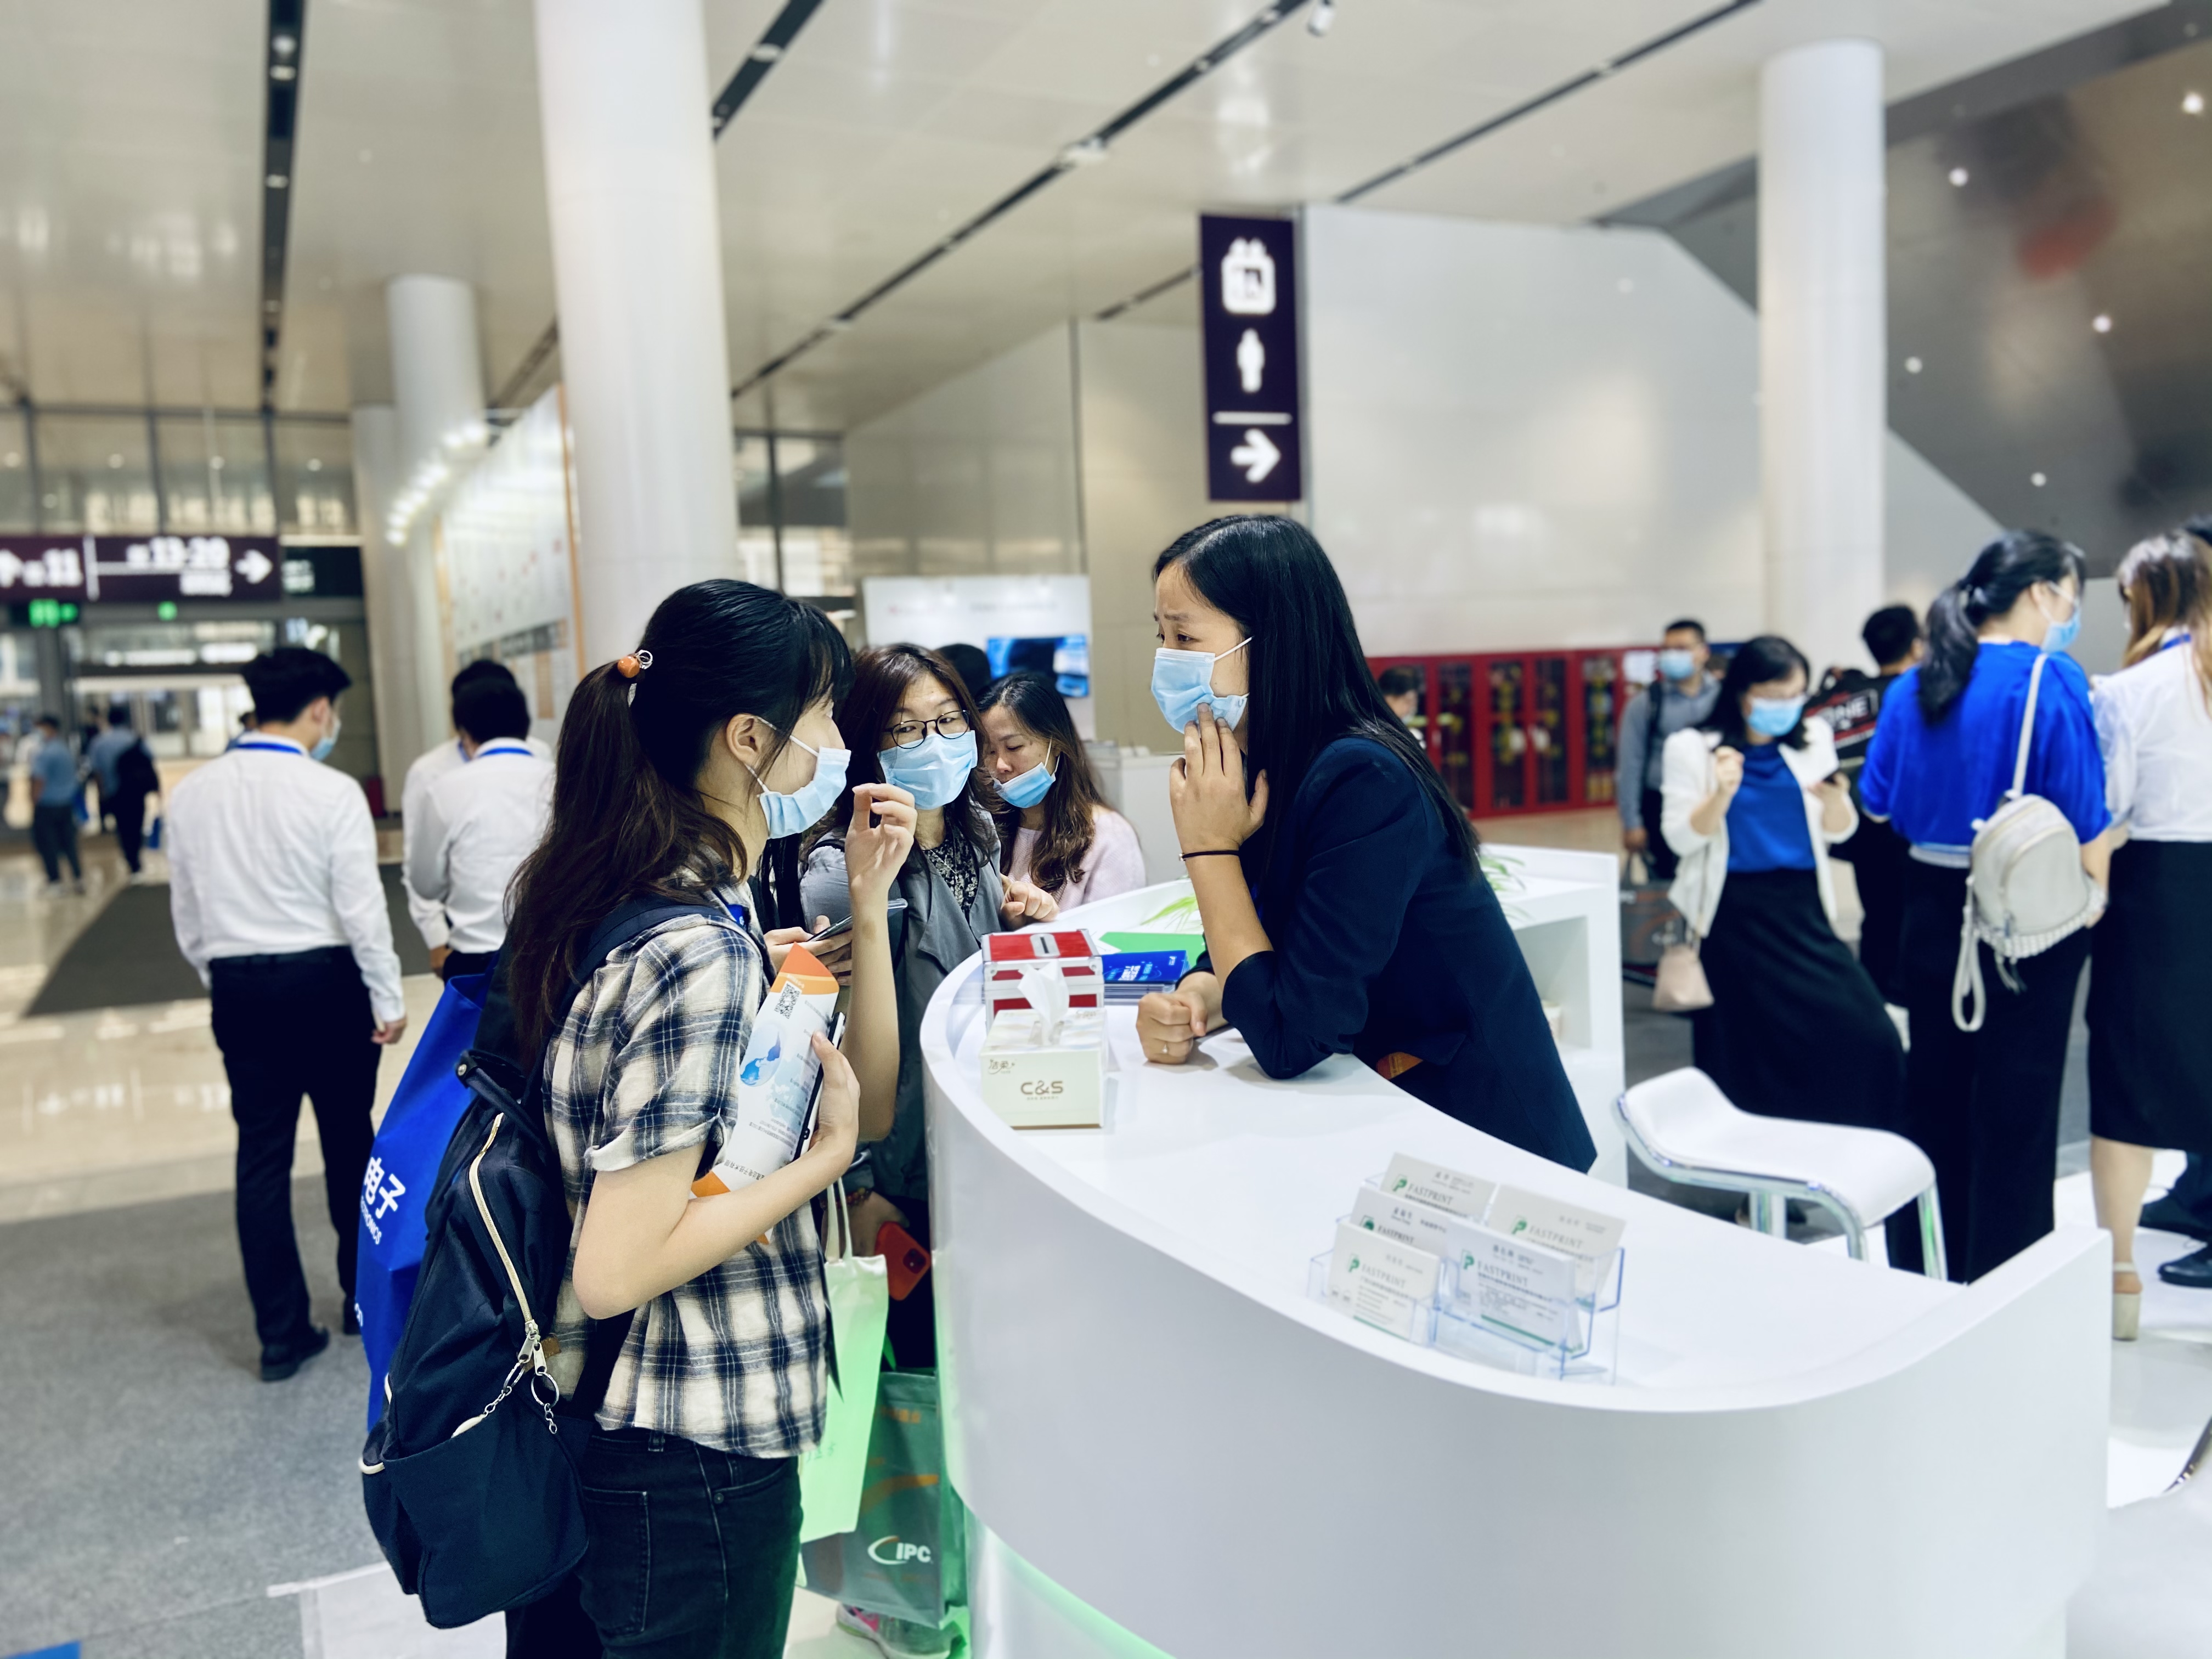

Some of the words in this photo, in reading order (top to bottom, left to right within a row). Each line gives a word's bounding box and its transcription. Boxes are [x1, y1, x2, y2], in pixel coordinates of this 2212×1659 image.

[1020, 1080, 1064, 1095] C&S
[364, 1156, 406, 1219] 电子
[1408, 1183, 1454, 1205] FASTPRINT
[1377, 1224, 1415, 1244] FASTPRINT
[1529, 1225, 1583, 1249] FASTPRINT
[1361, 1263, 1407, 1289] FASTPRINT
[1477, 1261, 1528, 1286] FASTPRINT
[895, 1542, 932, 1564] IPC
